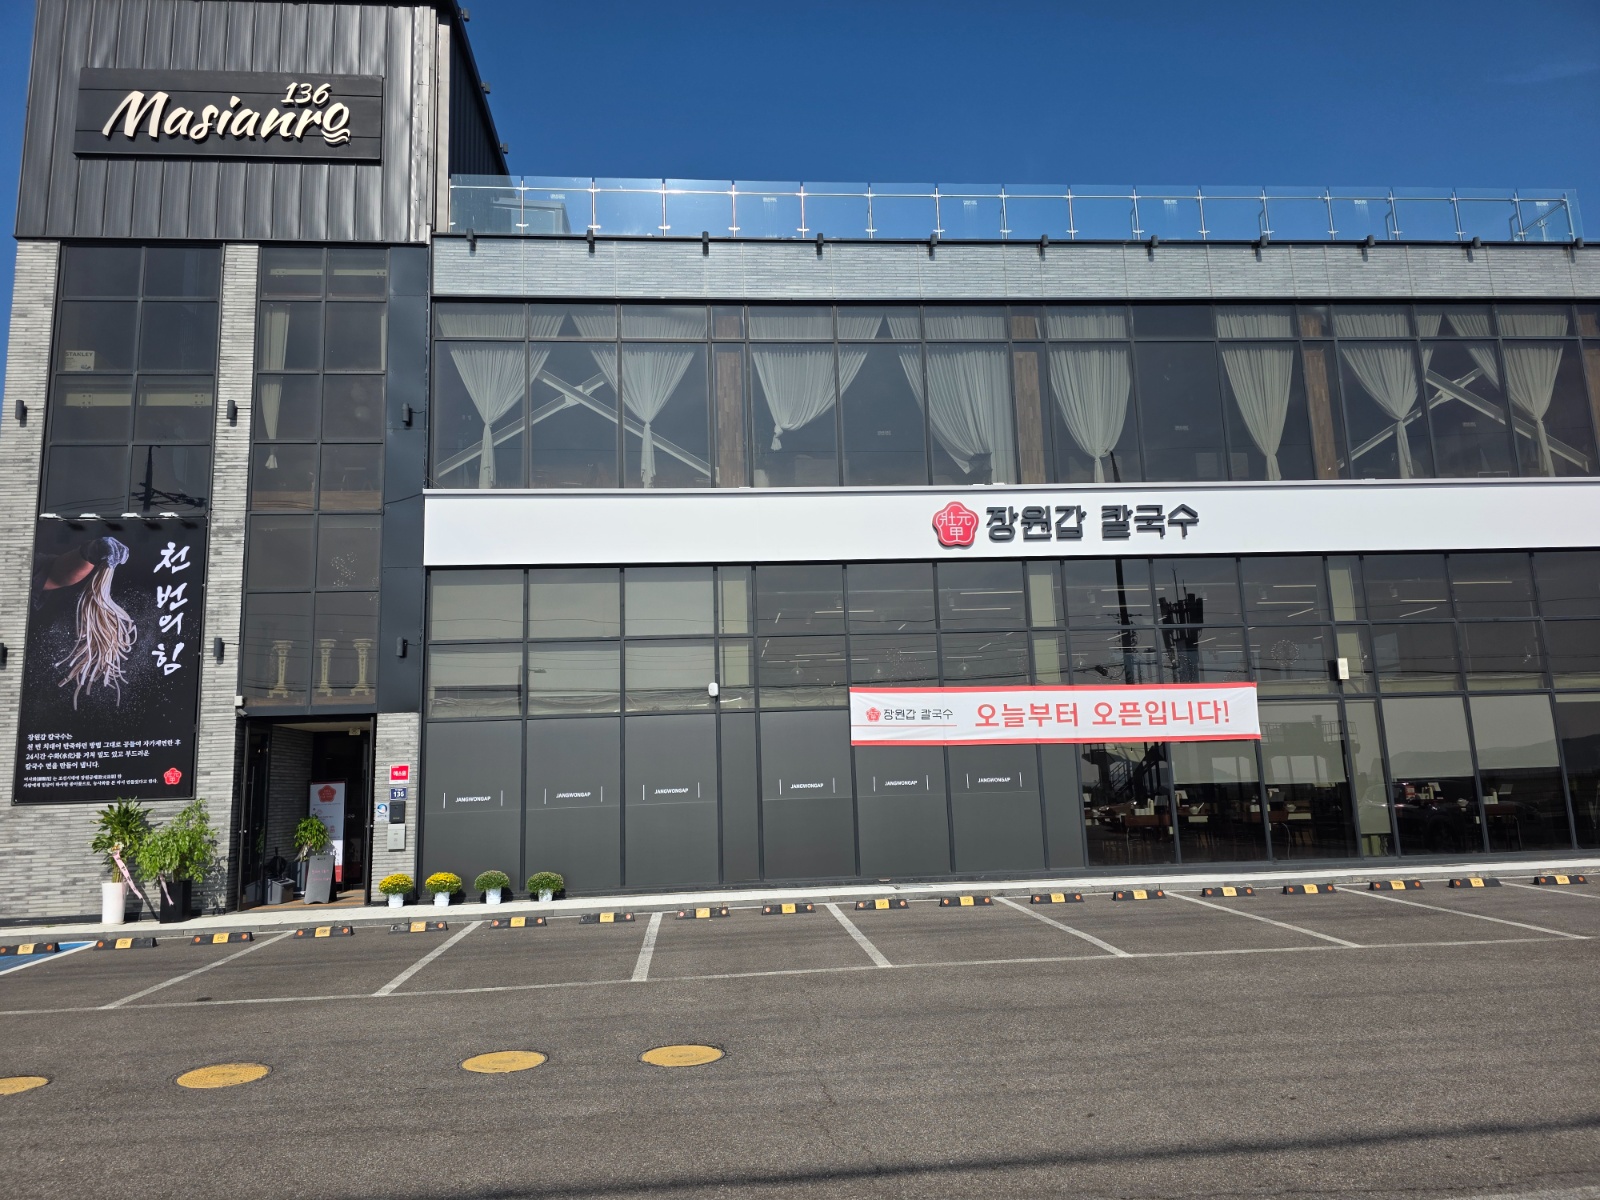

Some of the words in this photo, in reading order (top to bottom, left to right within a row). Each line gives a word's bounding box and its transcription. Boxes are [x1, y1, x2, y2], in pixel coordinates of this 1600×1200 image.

[282, 82, 331, 106] 136
[102, 90, 350, 142] Masianro
[986, 504, 1088, 542] 장원갑
[1100, 503, 1200, 540] 칼국수
[153, 542, 190, 575] 천
[151, 642, 186, 676] 힘
[884, 708, 916, 720] 장원갑
[920, 708, 954, 720] 칼국수
[975, 702, 1080, 728] 오늘부터
[1092, 700, 1230, 727] 오픈입니다!
